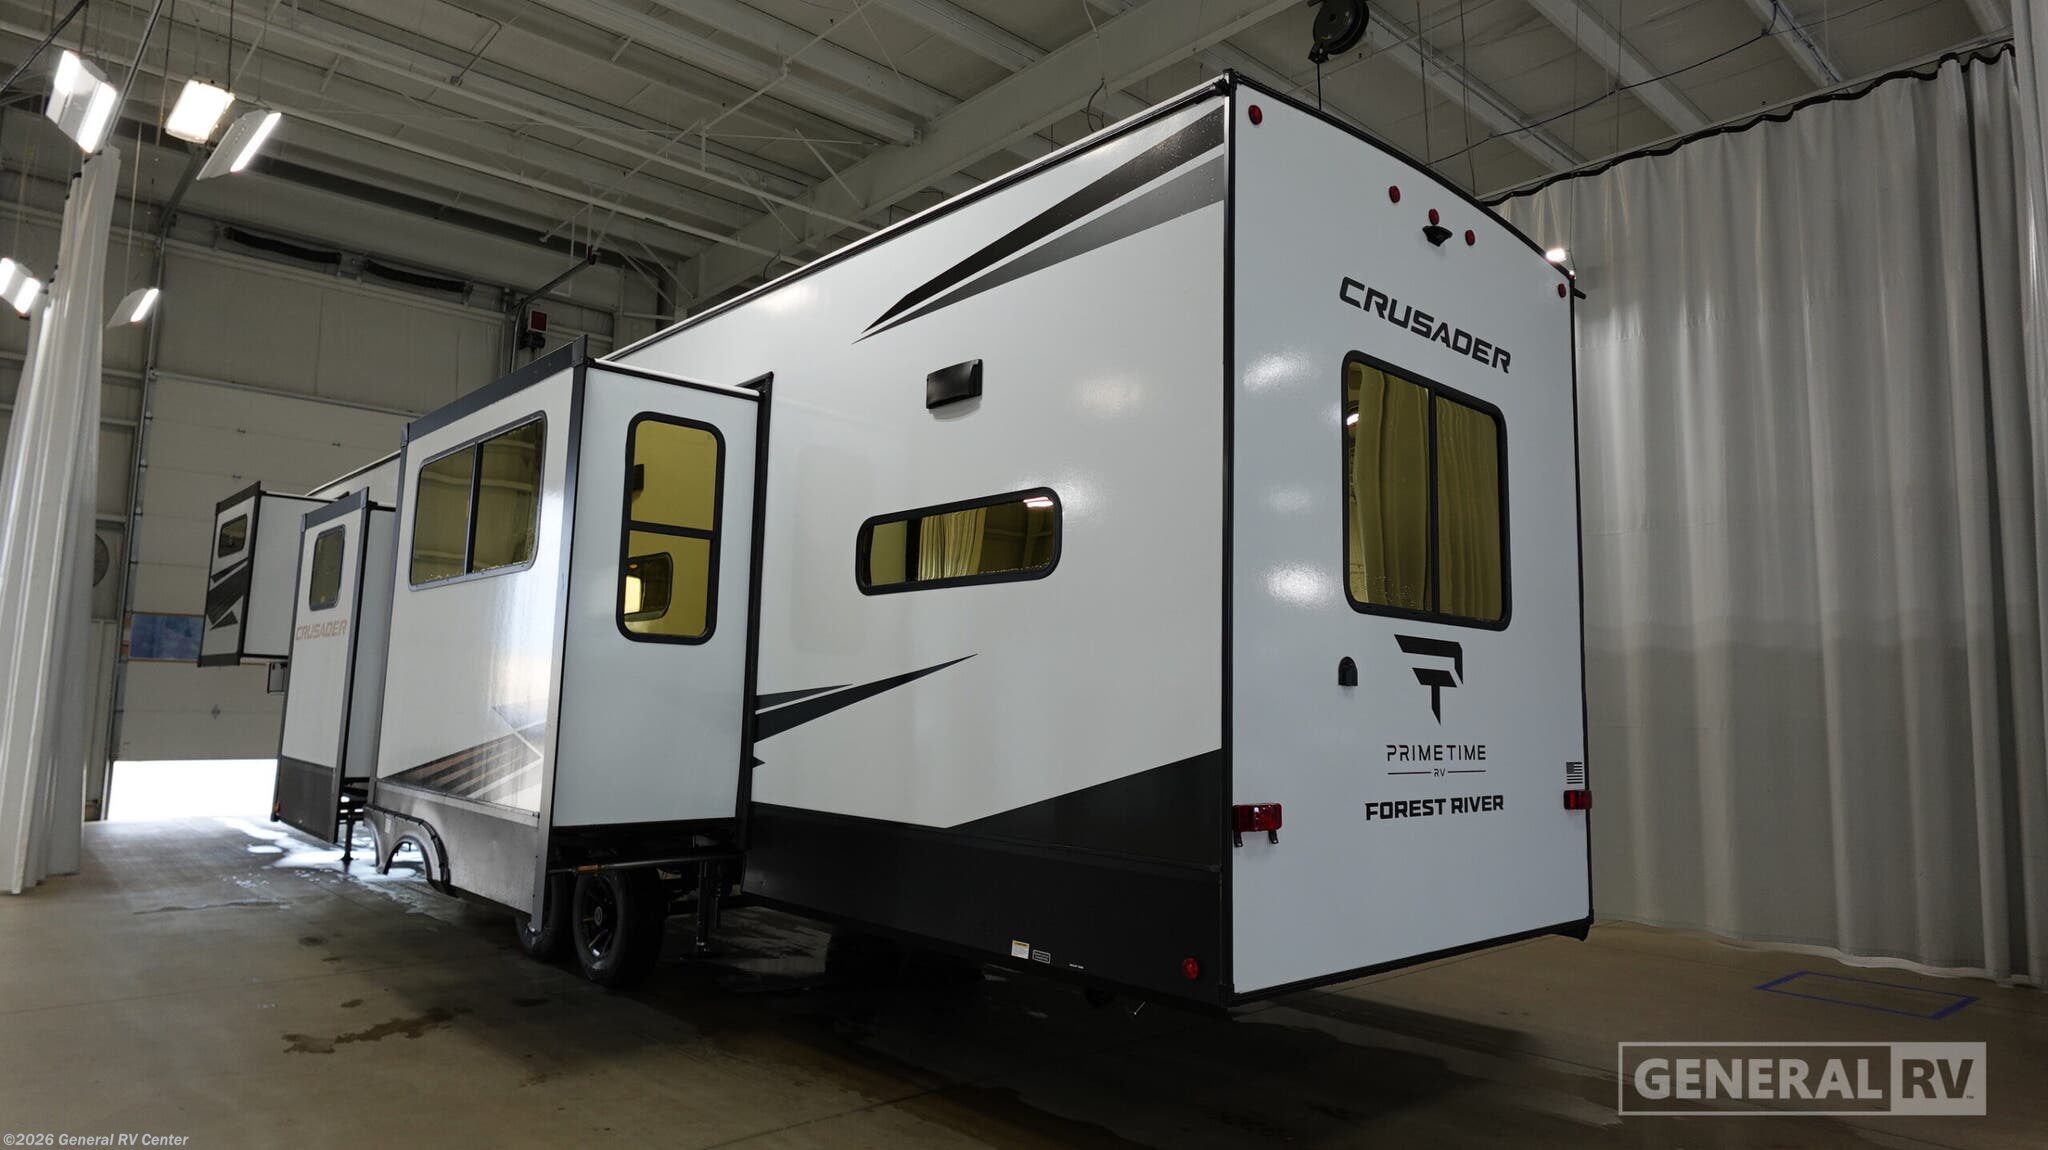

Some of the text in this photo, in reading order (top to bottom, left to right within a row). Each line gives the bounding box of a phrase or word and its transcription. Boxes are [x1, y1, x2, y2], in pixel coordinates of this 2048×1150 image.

[1339, 276, 1512, 374] CRUSADER
[295, 619, 347, 640] CRUSADER
[1386, 744, 1486, 762] PRIME TIME
[1433, 768, 1446, 777] RV
[1365, 794, 1504, 821] FOREST RIVER
